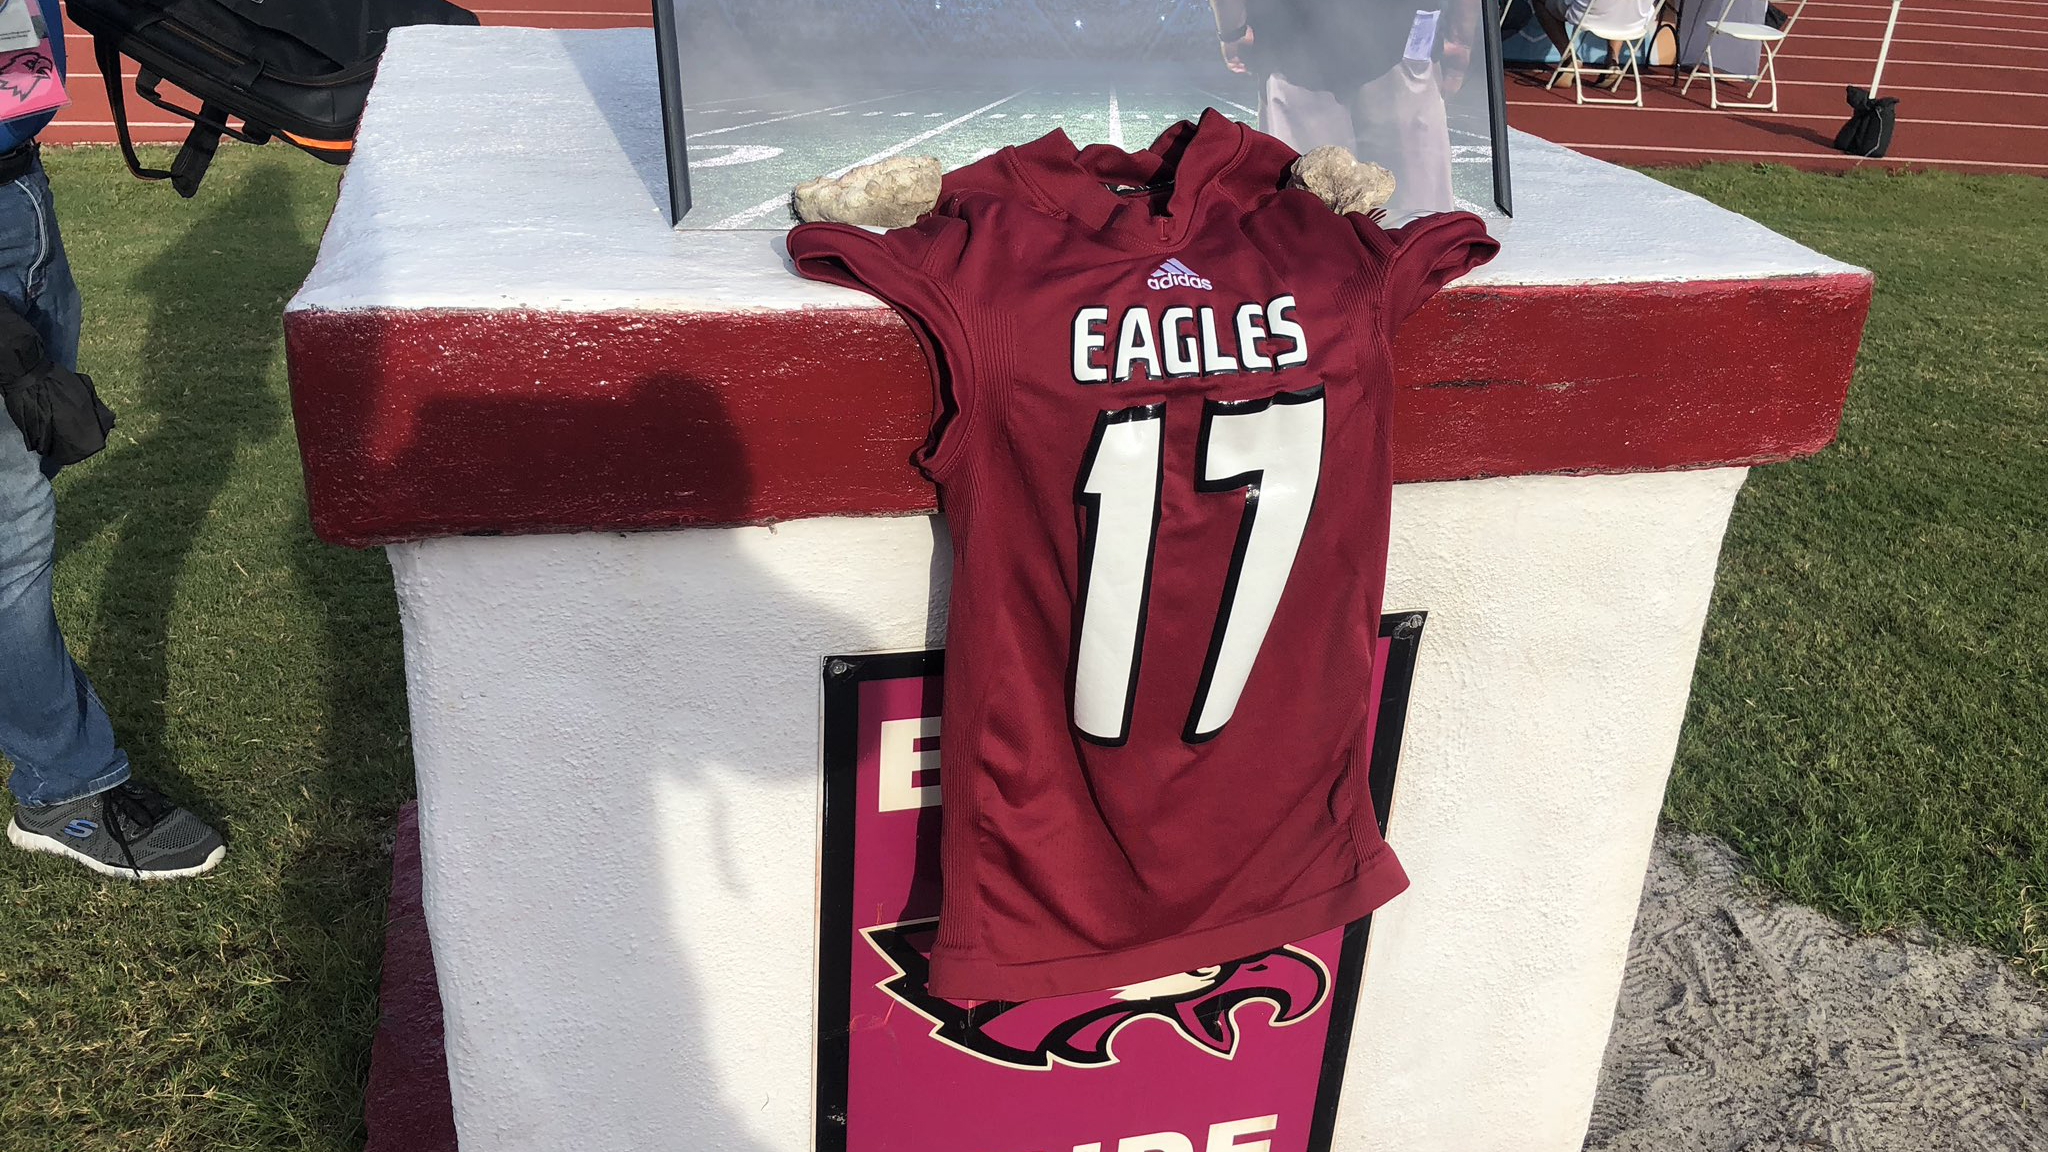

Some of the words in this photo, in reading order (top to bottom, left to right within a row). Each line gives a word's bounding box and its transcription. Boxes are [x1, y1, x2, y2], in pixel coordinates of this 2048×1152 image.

[1147, 272, 1213, 291] adidas
[1071, 292, 1308, 385] EAGLES
[1072, 384, 1326, 747] 17
